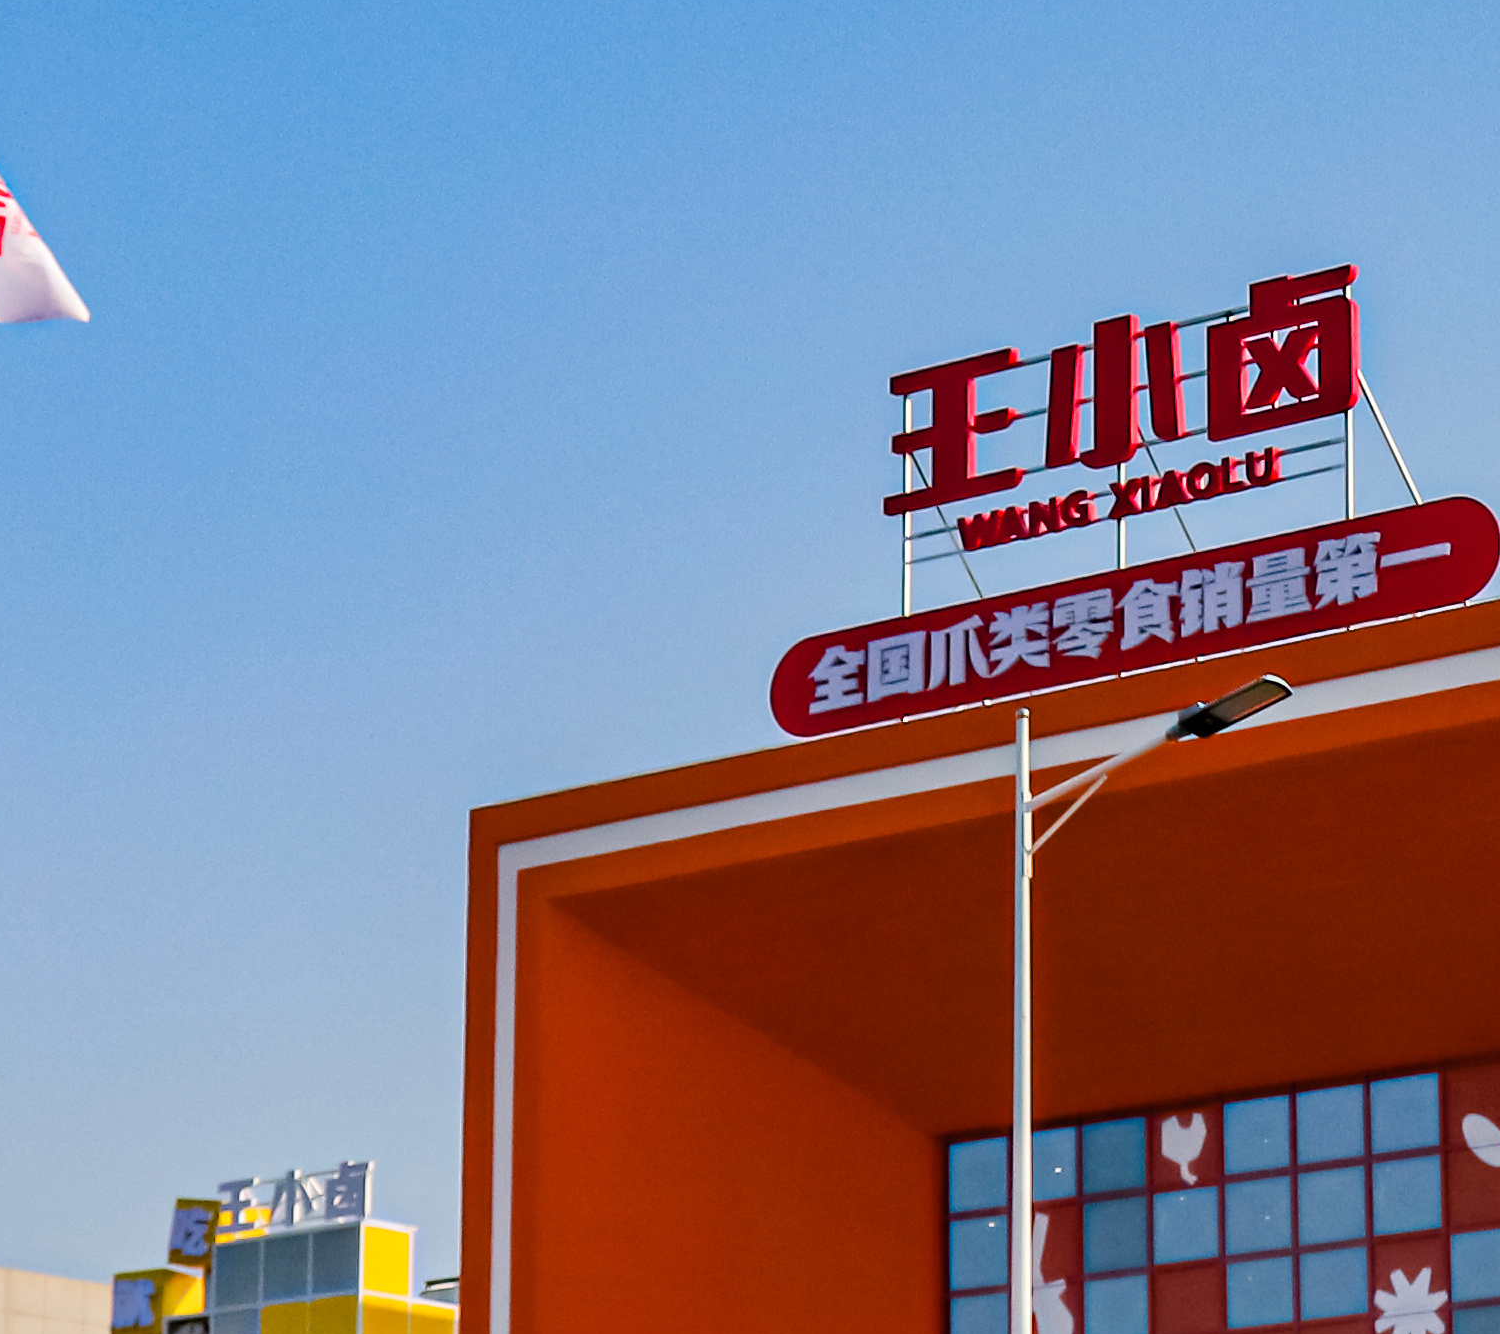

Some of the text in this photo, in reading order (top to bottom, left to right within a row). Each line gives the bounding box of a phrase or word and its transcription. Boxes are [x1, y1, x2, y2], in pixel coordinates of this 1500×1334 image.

[883, 264, 1360, 516] 王小卤
[957, 445, 1283, 552] WANG XIAOLU
[807, 530, 1453, 716] 全国爪类零食销量第一
